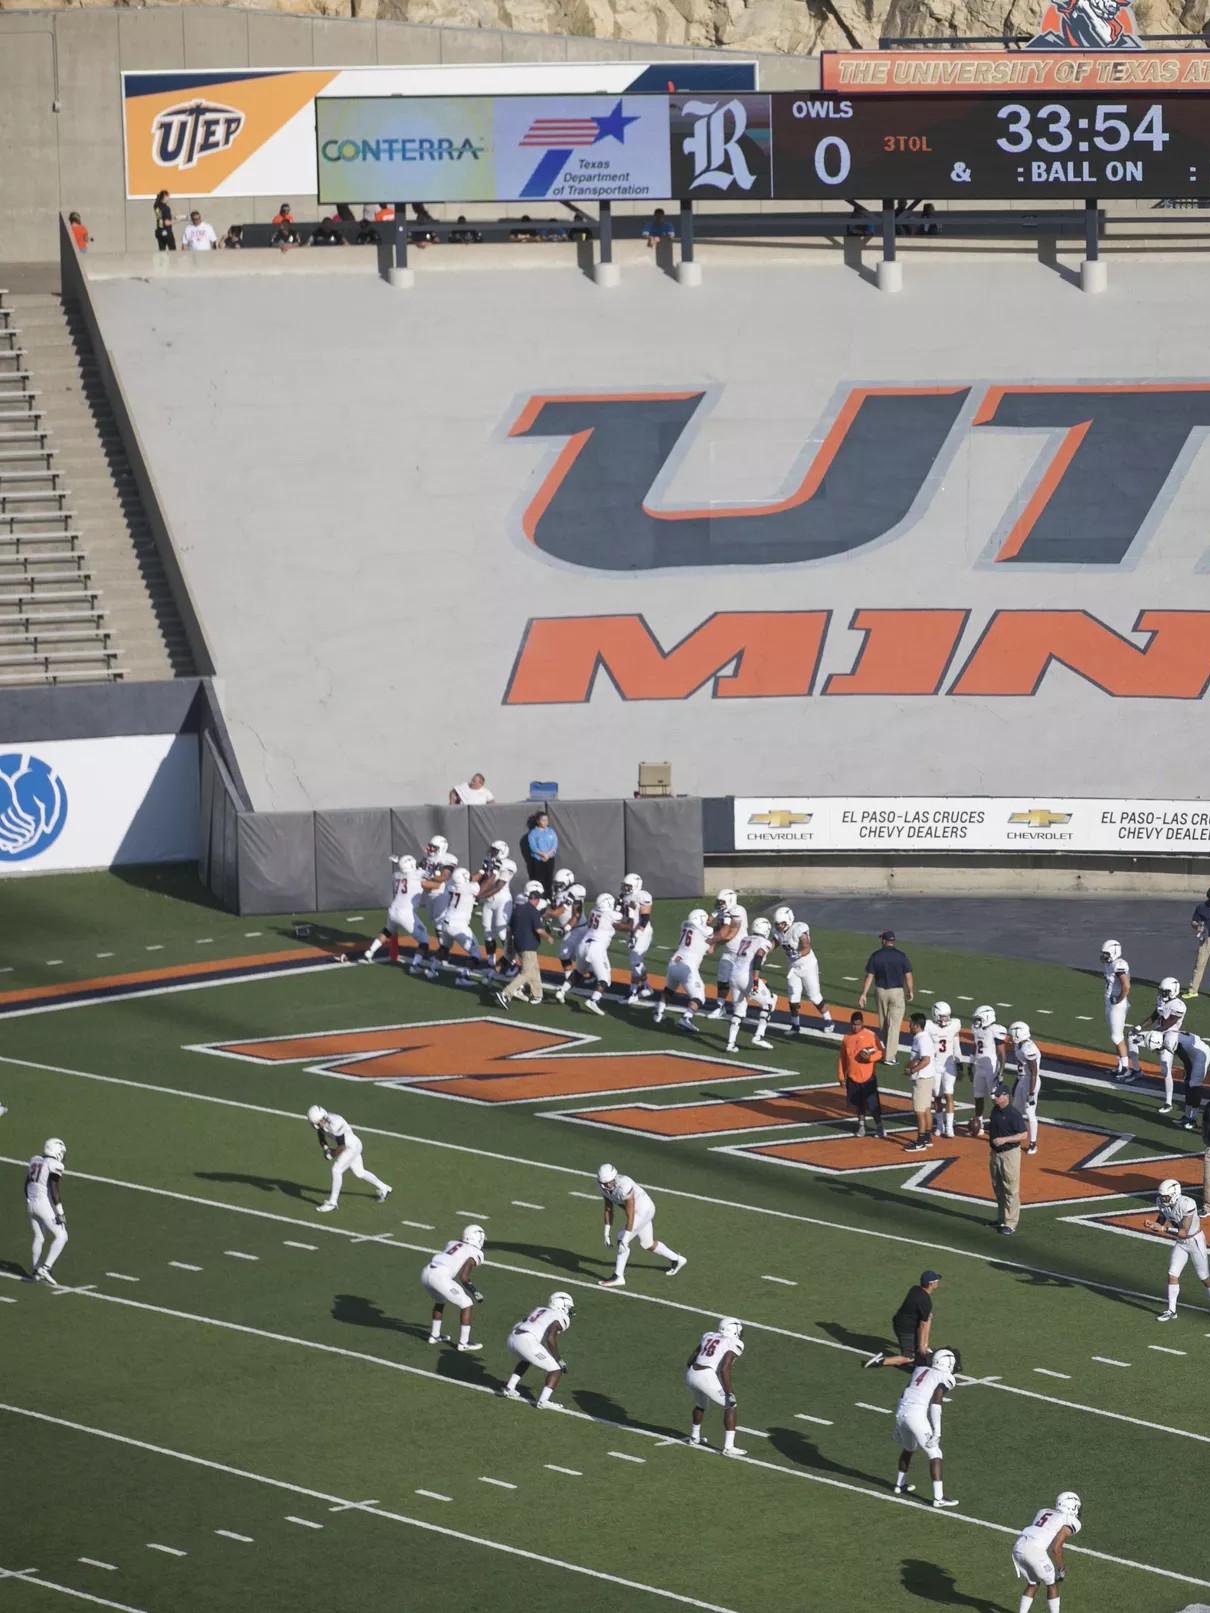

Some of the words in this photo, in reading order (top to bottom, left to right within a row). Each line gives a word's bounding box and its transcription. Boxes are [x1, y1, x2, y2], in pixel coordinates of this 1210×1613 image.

[838, 60, 890, 84] THE
[893, 60, 1051, 84] UNIVERSITY
[1054, 60, 1089, 84] OF
[1097, 60, 1180, 84] TEXAS
[792, 101, 854, 119] OWLS
[153, 100, 245, 168] UTEP
[996, 104, 1170, 153] 33:54
[321, 137, 481, 162] CONTERRA
[579, 159, 610, 169] Texas
[814, 136, 851, 185] 0
[564, 172, 630, 184] Department
[950, 161, 972, 182] &
[1106, 161, 1143, 181] ON
[553, 185, 565, 195] of
[566, 184, 649, 197] Transportation
[842, 811, 858, 823] EL
[861, 811, 930, 823] PASO-LAS
[933, 811, 985, 823] CRUCES
[1101, 811, 1117, 824] EL
[1120, 812, 1189, 825] PASO-LAS
[747, 832, 813, 840] CHEVROLET
[859, 826, 905, 838] CHEVY
[907, 826, 967, 838] DEALERS
[1007, 831, 1073, 840] CHEVROLET
[1118, 827, 1163, 840] CHEVY
[939, 1039, 946, 1053] 3
[446, 1243, 463, 1255] 6
[701, 1339, 720, 1357] 16
[915, 1369, 929, 1386] 4
[1035, 1513, 1053, 1527] 5
